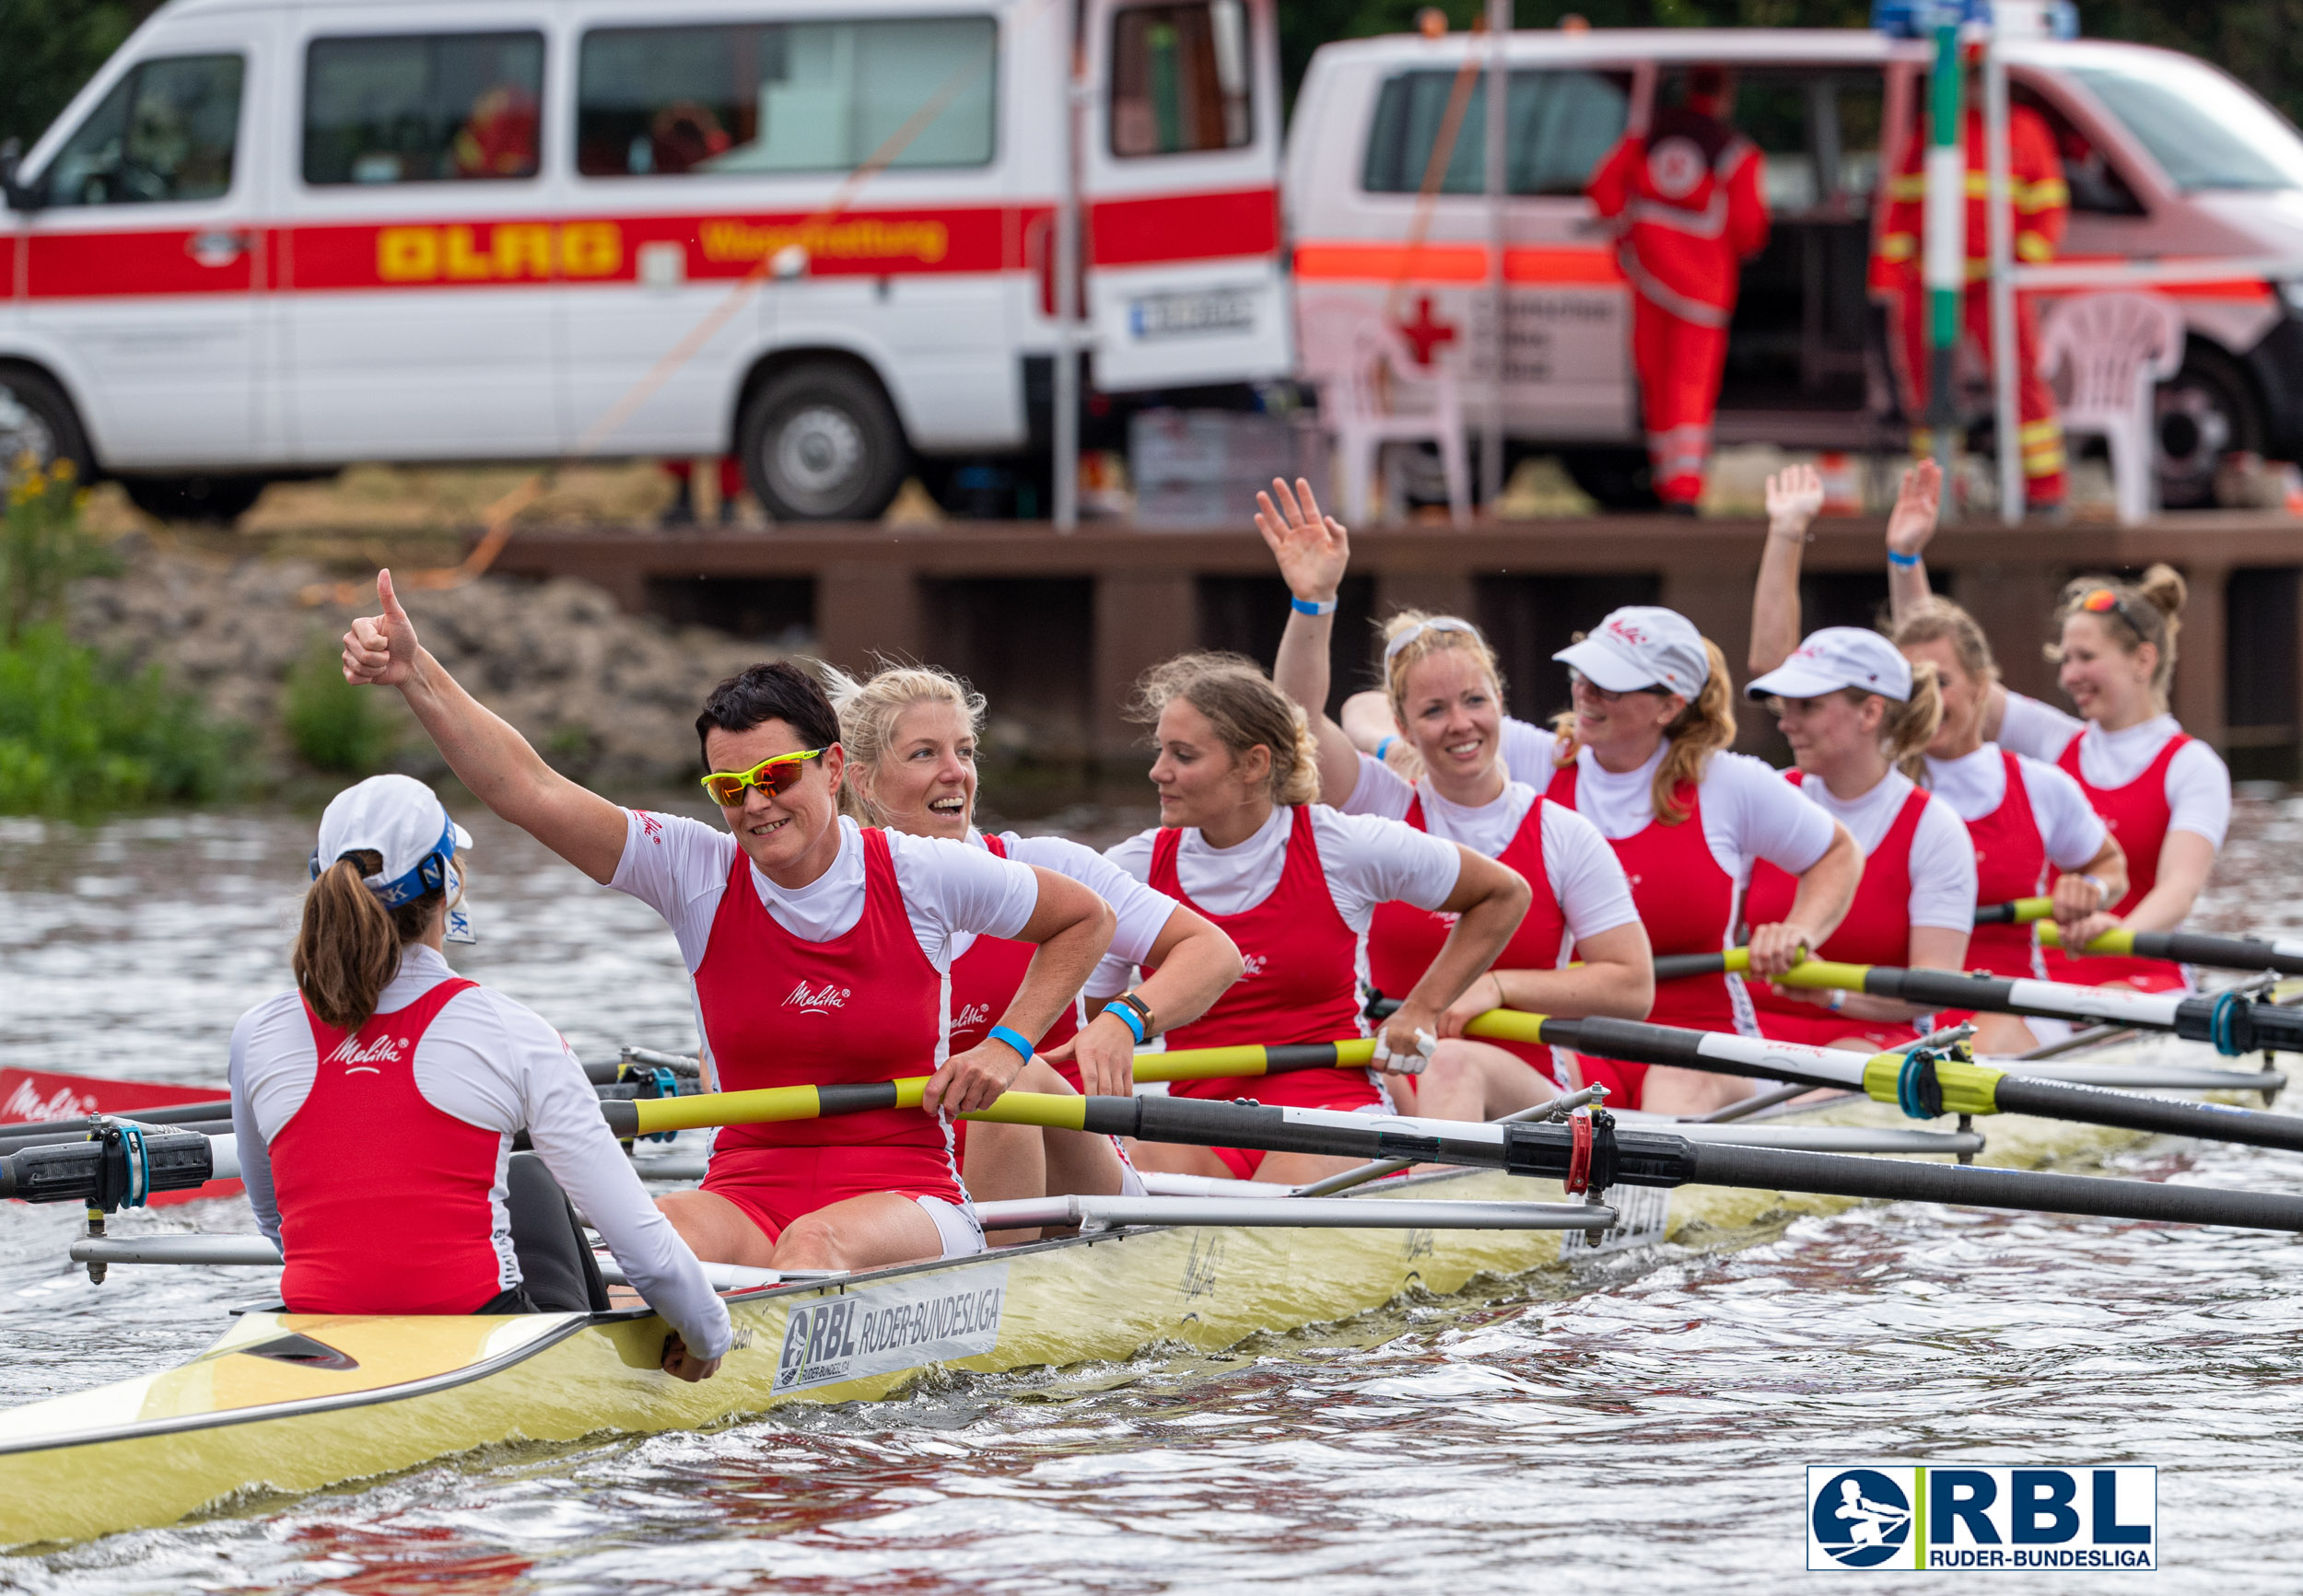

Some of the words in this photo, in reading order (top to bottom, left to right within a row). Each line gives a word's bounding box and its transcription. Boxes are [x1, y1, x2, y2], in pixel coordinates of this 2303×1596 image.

[376, 221, 623, 280] DLRG
[806, 1300, 856, 1365] RBL
[858, 1287, 1000, 1356] RUDER-BUNDESLIGA
